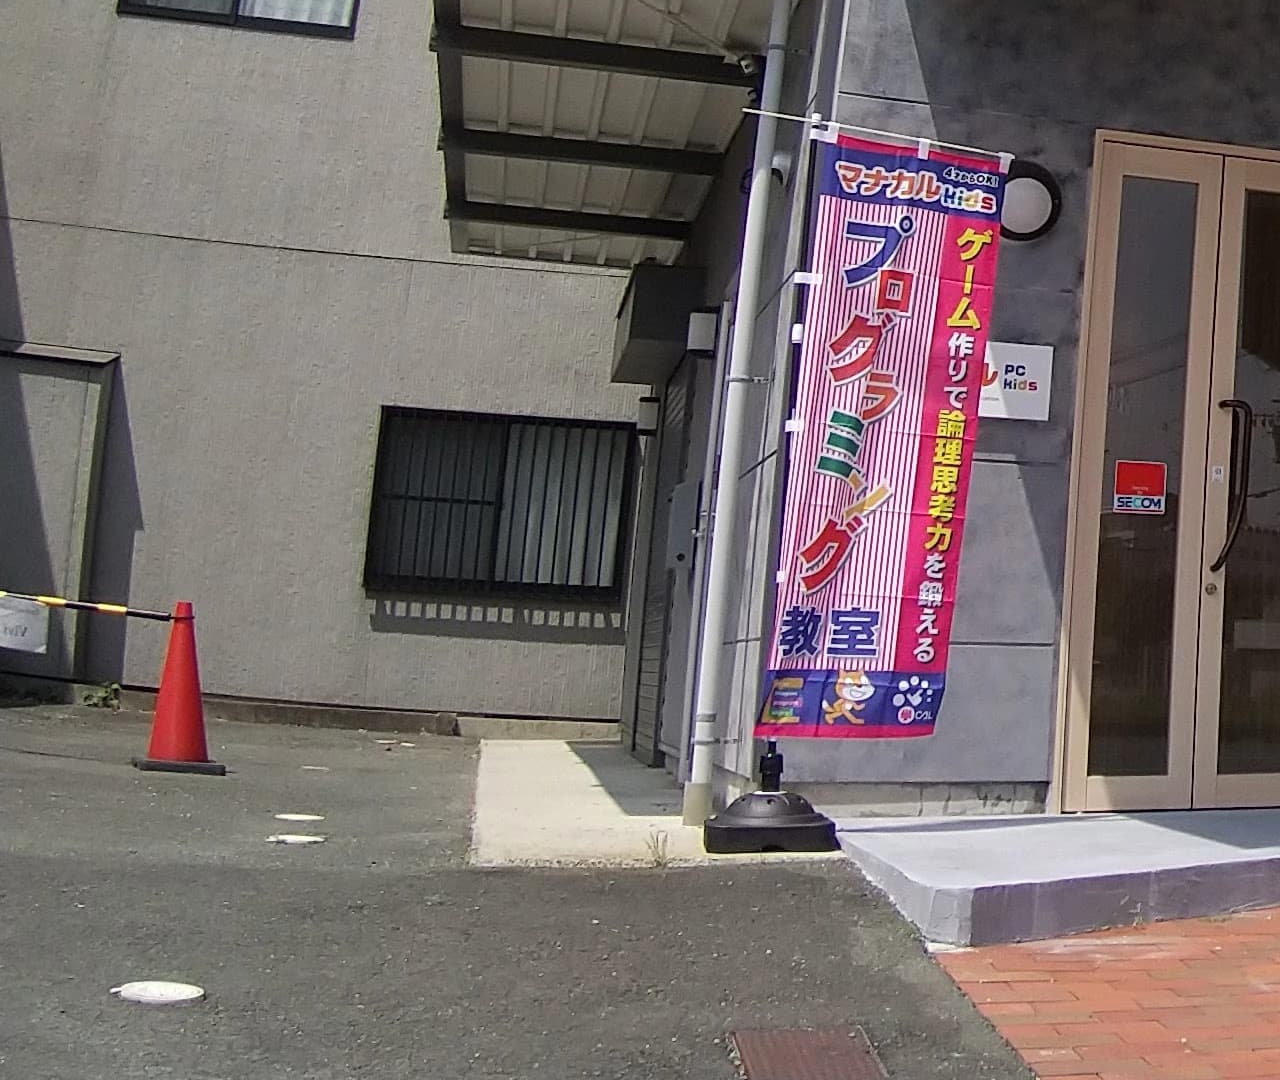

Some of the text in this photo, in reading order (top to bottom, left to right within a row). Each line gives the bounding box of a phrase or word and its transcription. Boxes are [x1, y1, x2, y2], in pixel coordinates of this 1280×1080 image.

[835, 160, 941, 202] マナカル
[1003, 378, 1038, 391] kids
[1005, 364, 1026, 376] PC
[798, 215, 916, 597] プログラミング
[912, 227, 993, 663] ゲーム作りで論理思考力を鍛える
[1117, 497, 1161, 509] SECOM
[778, 605, 880, 658] 教室
